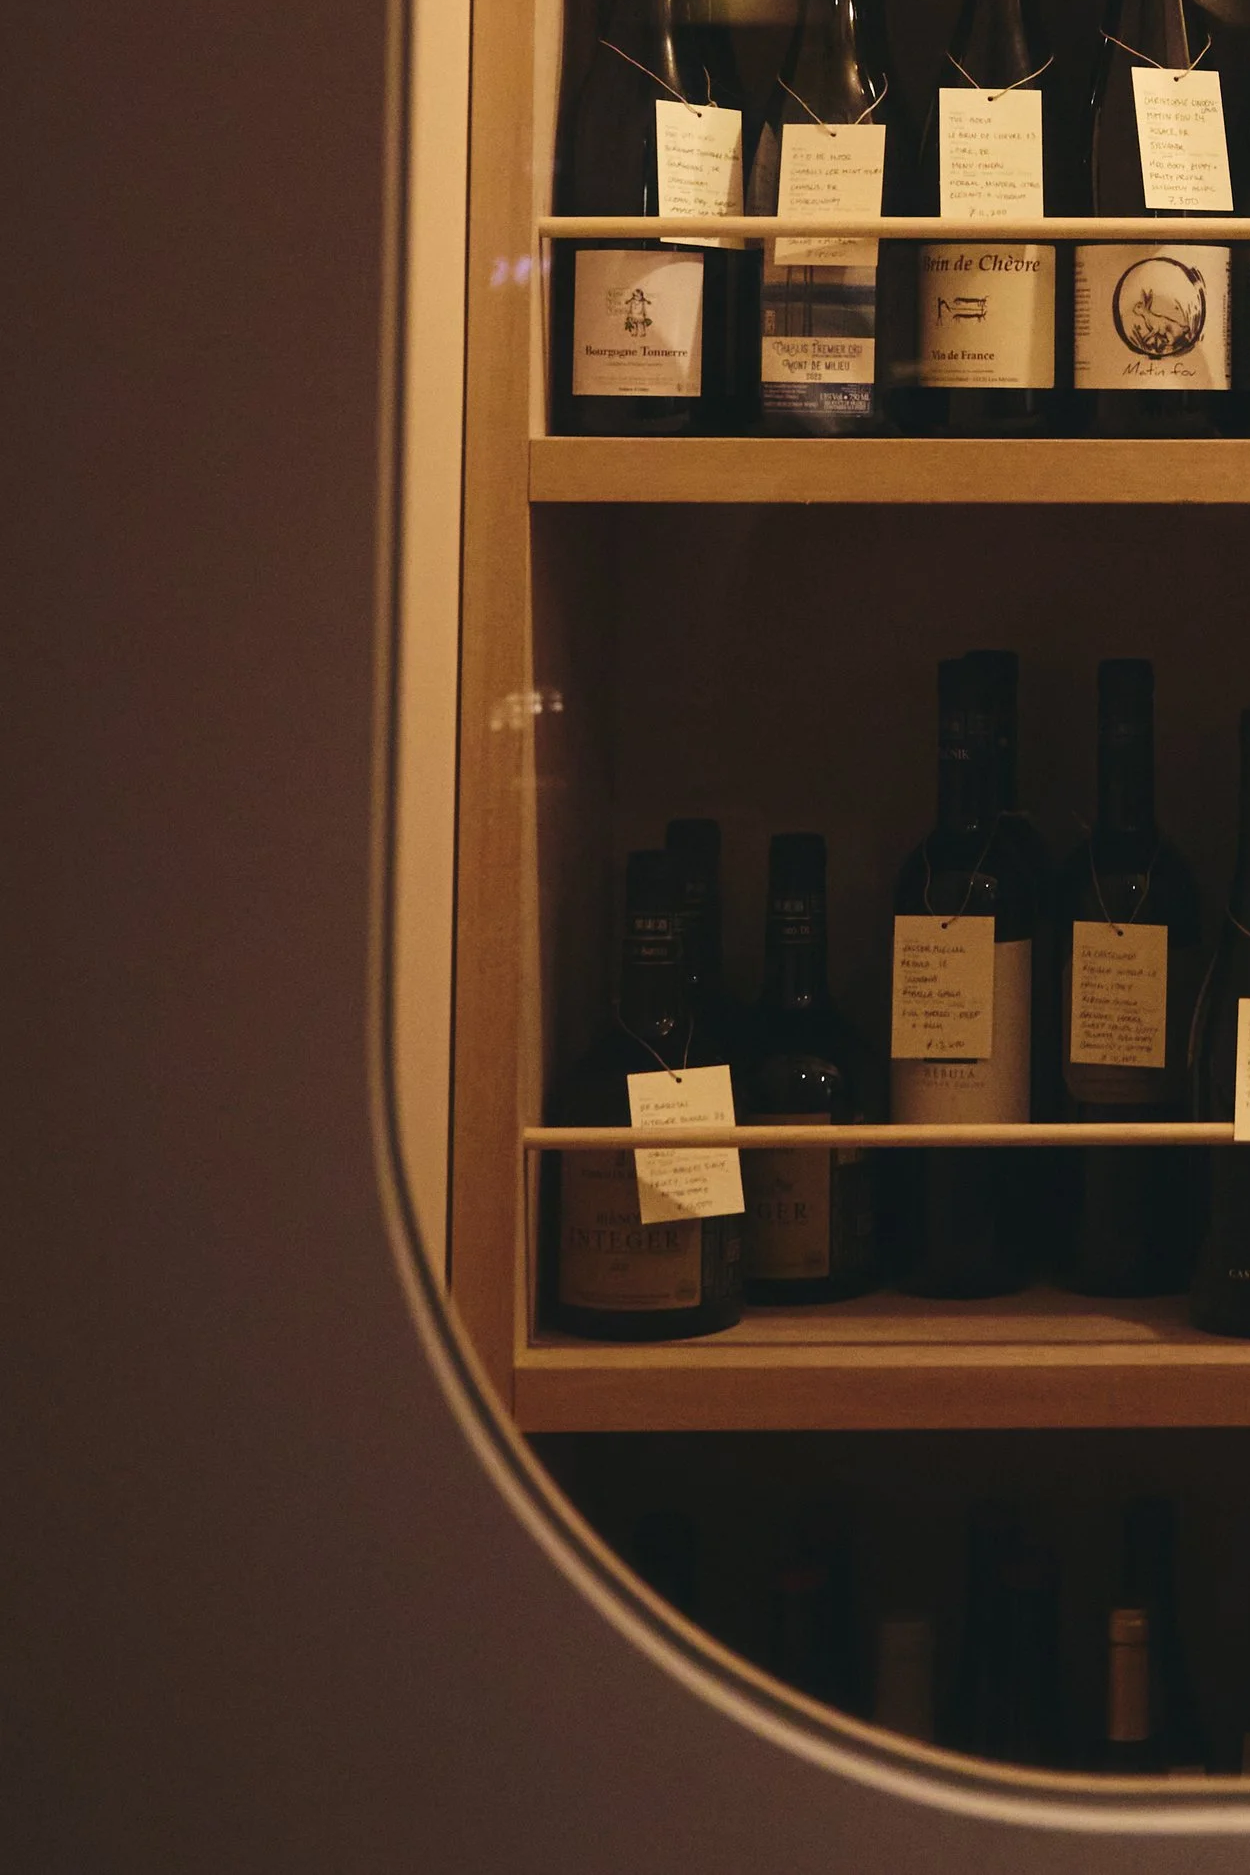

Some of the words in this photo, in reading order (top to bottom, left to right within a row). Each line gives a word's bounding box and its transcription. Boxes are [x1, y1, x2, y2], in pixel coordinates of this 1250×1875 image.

[922, 255, 950, 272] Brin
[953, 254, 973, 271] de
[979, 254, 1041, 272] Chèvre
[585, 345, 638, 359] Bourgogne
[640, 345, 688, 357] Tonnerre
[931, 350, 946, 361] Vin
[947, 350, 959, 361] de
[961, 350, 995, 361] France
[811, 360, 821, 371] DE
[825, 360, 850, 372] MILIEU
